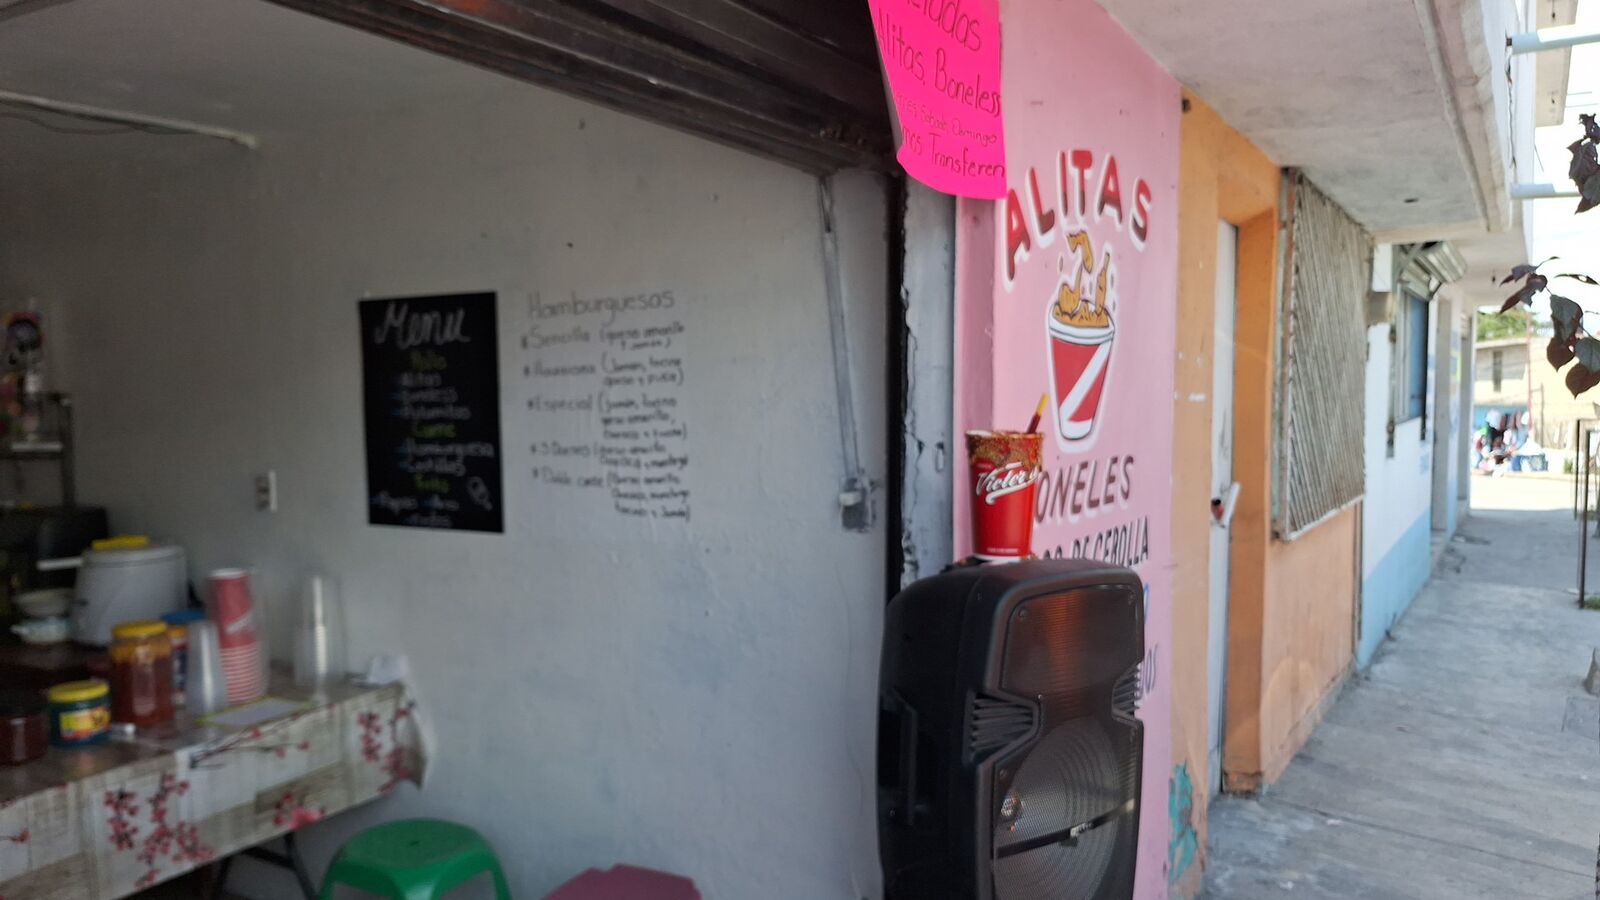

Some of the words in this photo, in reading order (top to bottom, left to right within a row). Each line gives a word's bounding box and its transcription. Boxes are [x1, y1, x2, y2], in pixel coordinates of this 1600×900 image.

[934, 47, 1001, 118] Boneless
[951, 117, 997, 148] Domingo
[1005, 150, 1152, 284] ALITAS
[1035, 455, 1135, 523] ONELES
